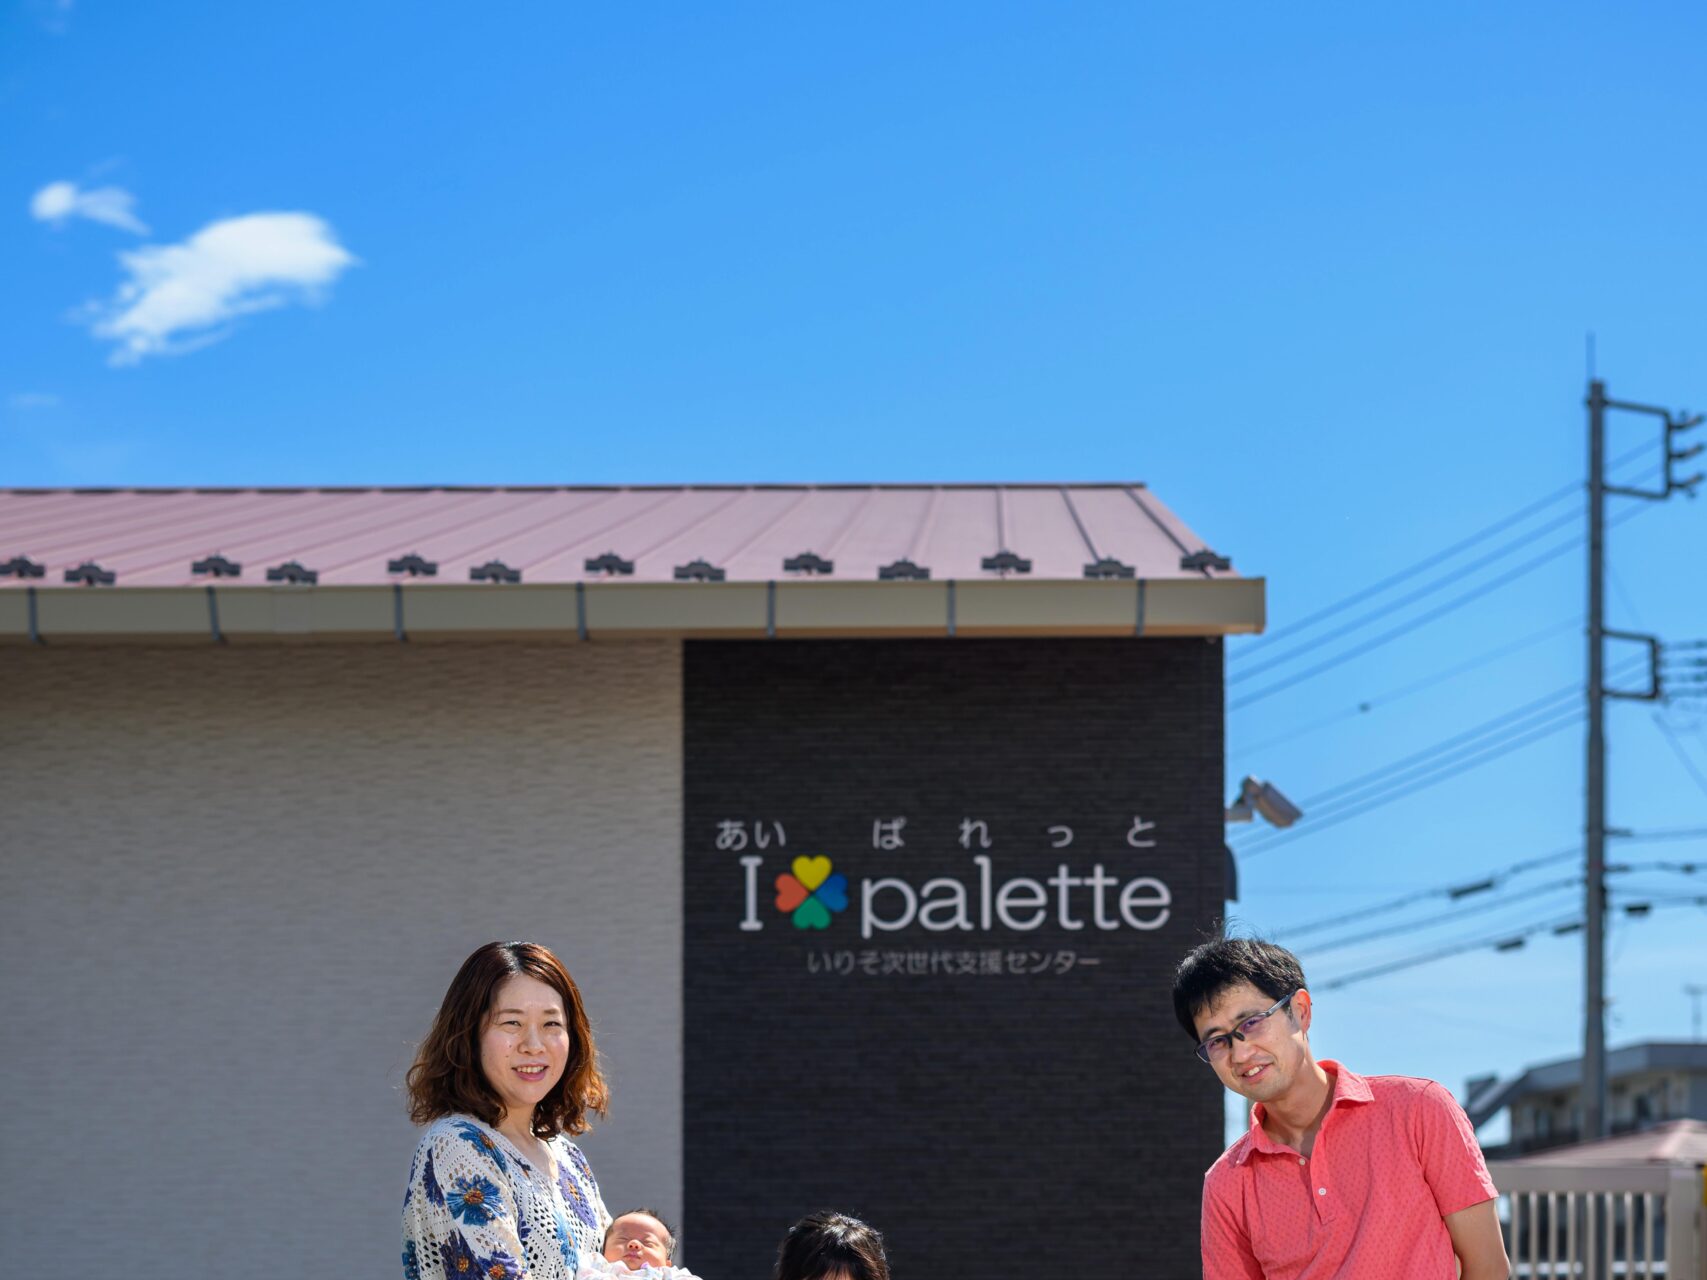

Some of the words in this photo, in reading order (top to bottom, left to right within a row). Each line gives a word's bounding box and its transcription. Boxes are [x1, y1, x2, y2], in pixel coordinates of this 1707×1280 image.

[715, 819, 786, 851] あい
[739, 856, 763, 931] I
[861, 855, 1172, 939] palette
[807, 949, 1101, 975] いりそ次世代支援センター
